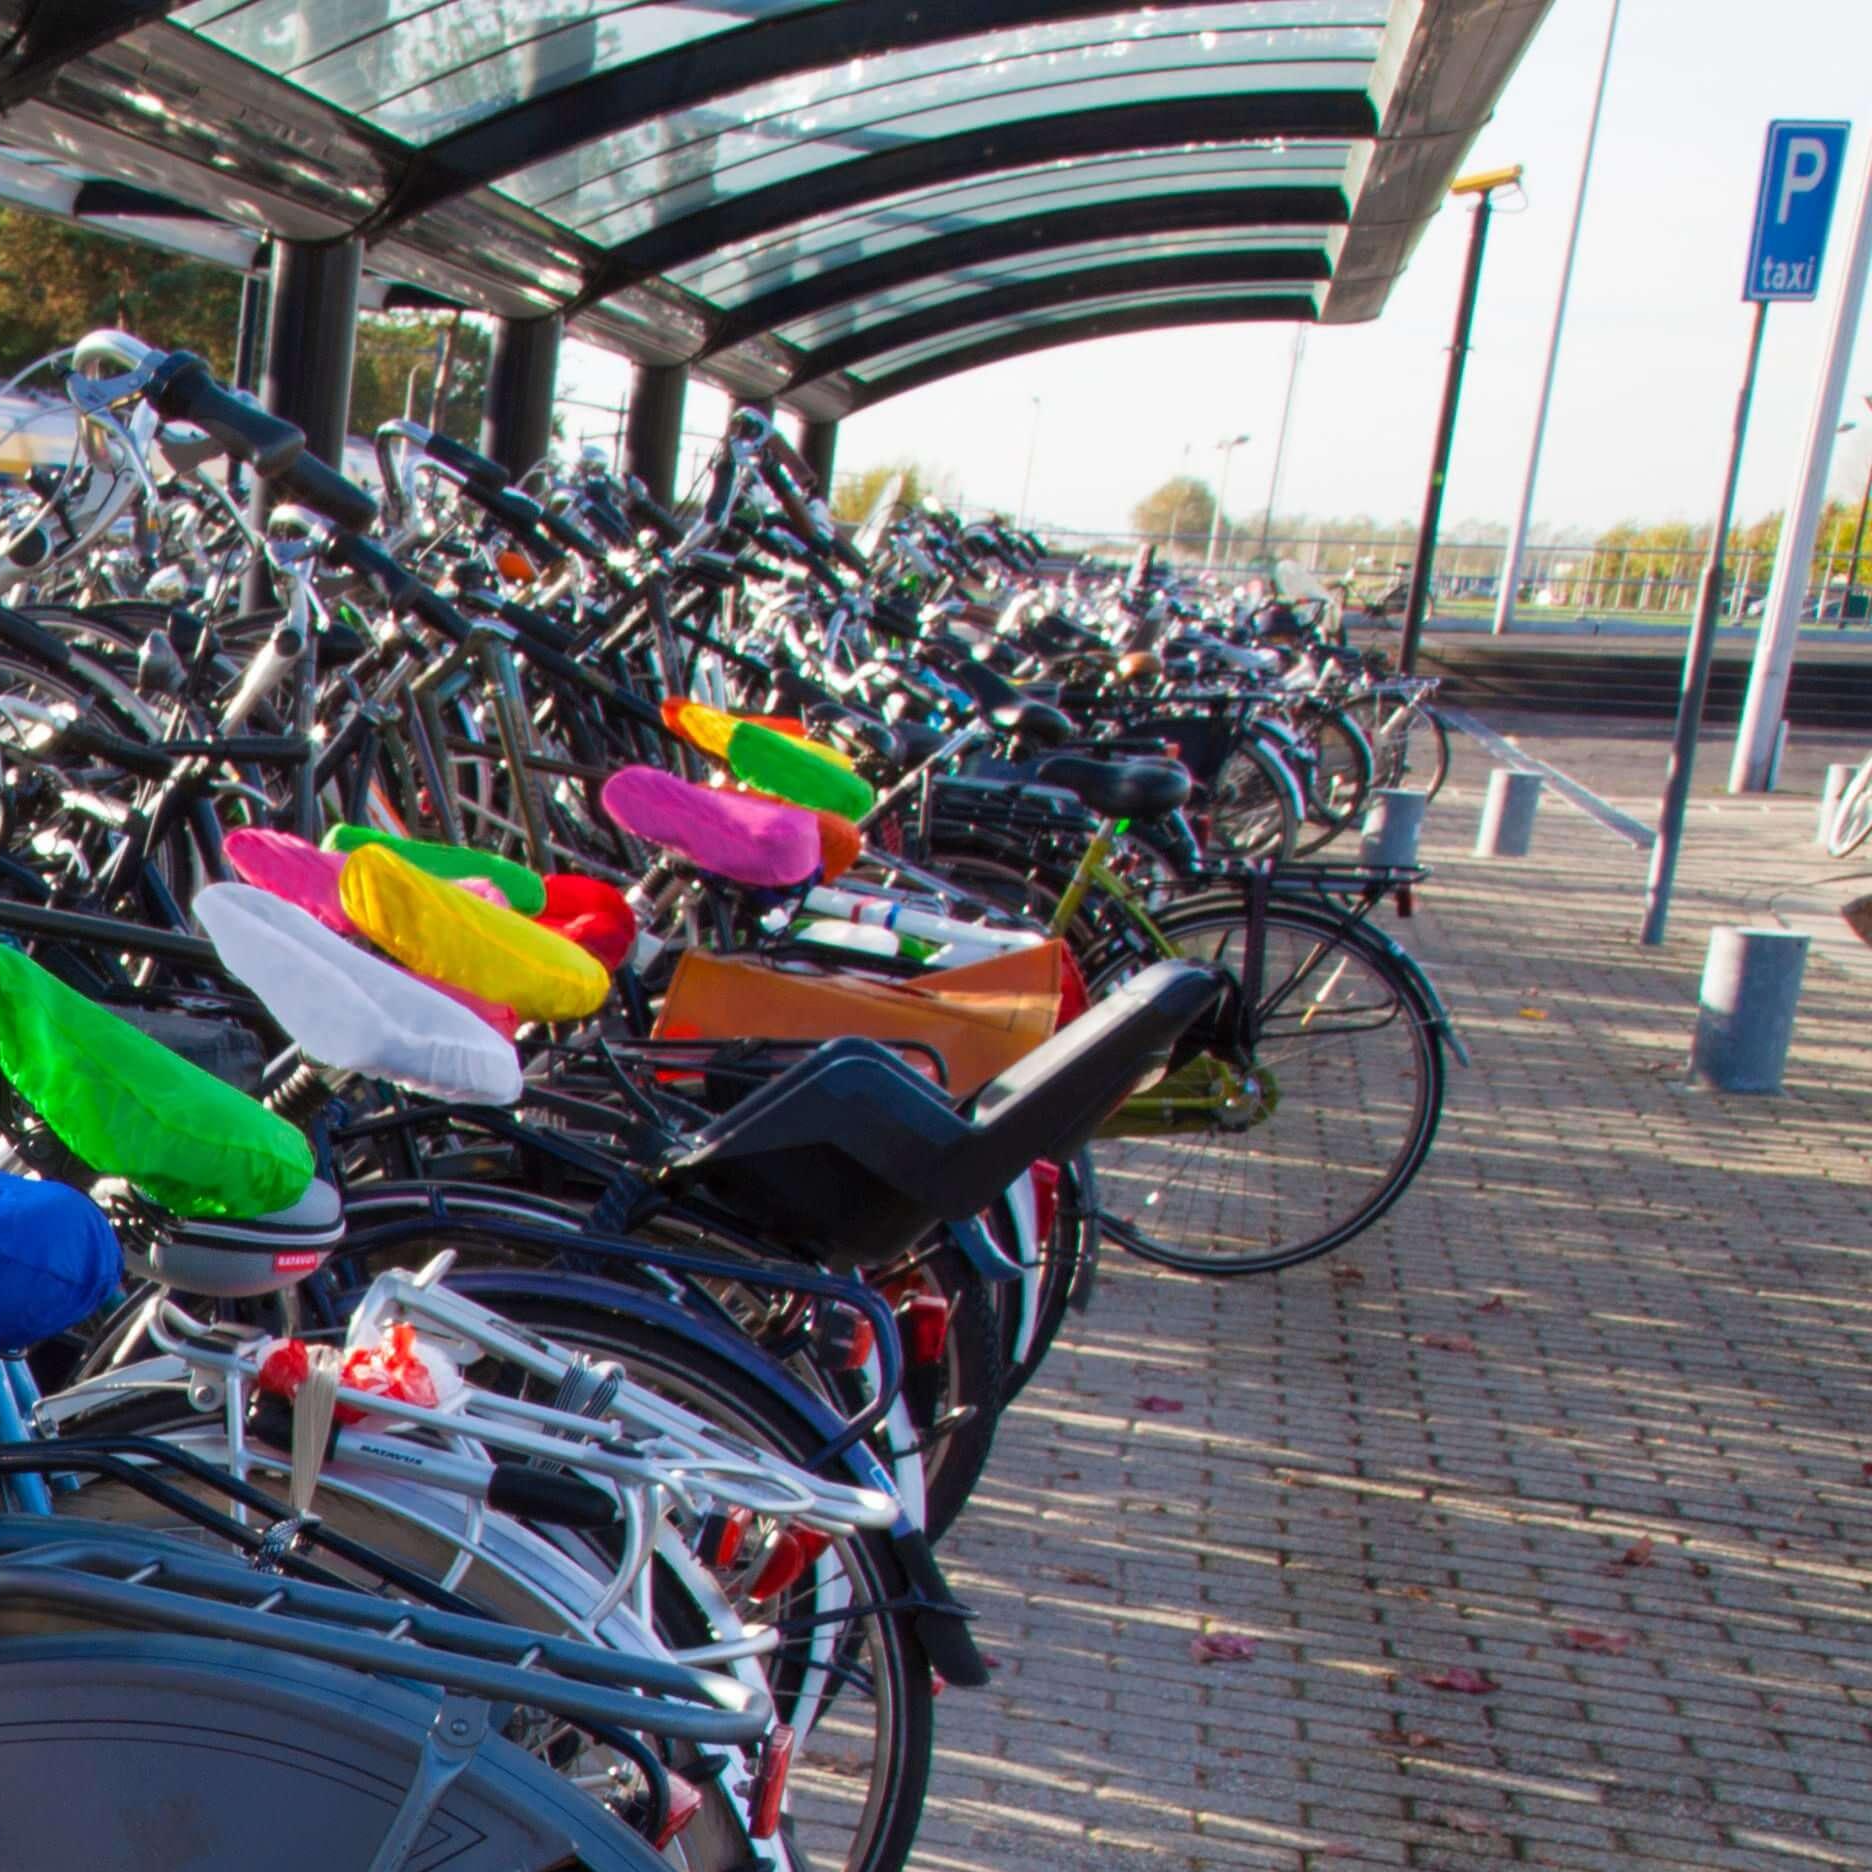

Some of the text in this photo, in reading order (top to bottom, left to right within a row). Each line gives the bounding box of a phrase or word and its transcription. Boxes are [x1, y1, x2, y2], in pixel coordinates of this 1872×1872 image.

[1777, 137, 1829, 225] P
[1762, 255, 1817, 290] taxi
[359, 1444, 424, 1466] BATAVUS
